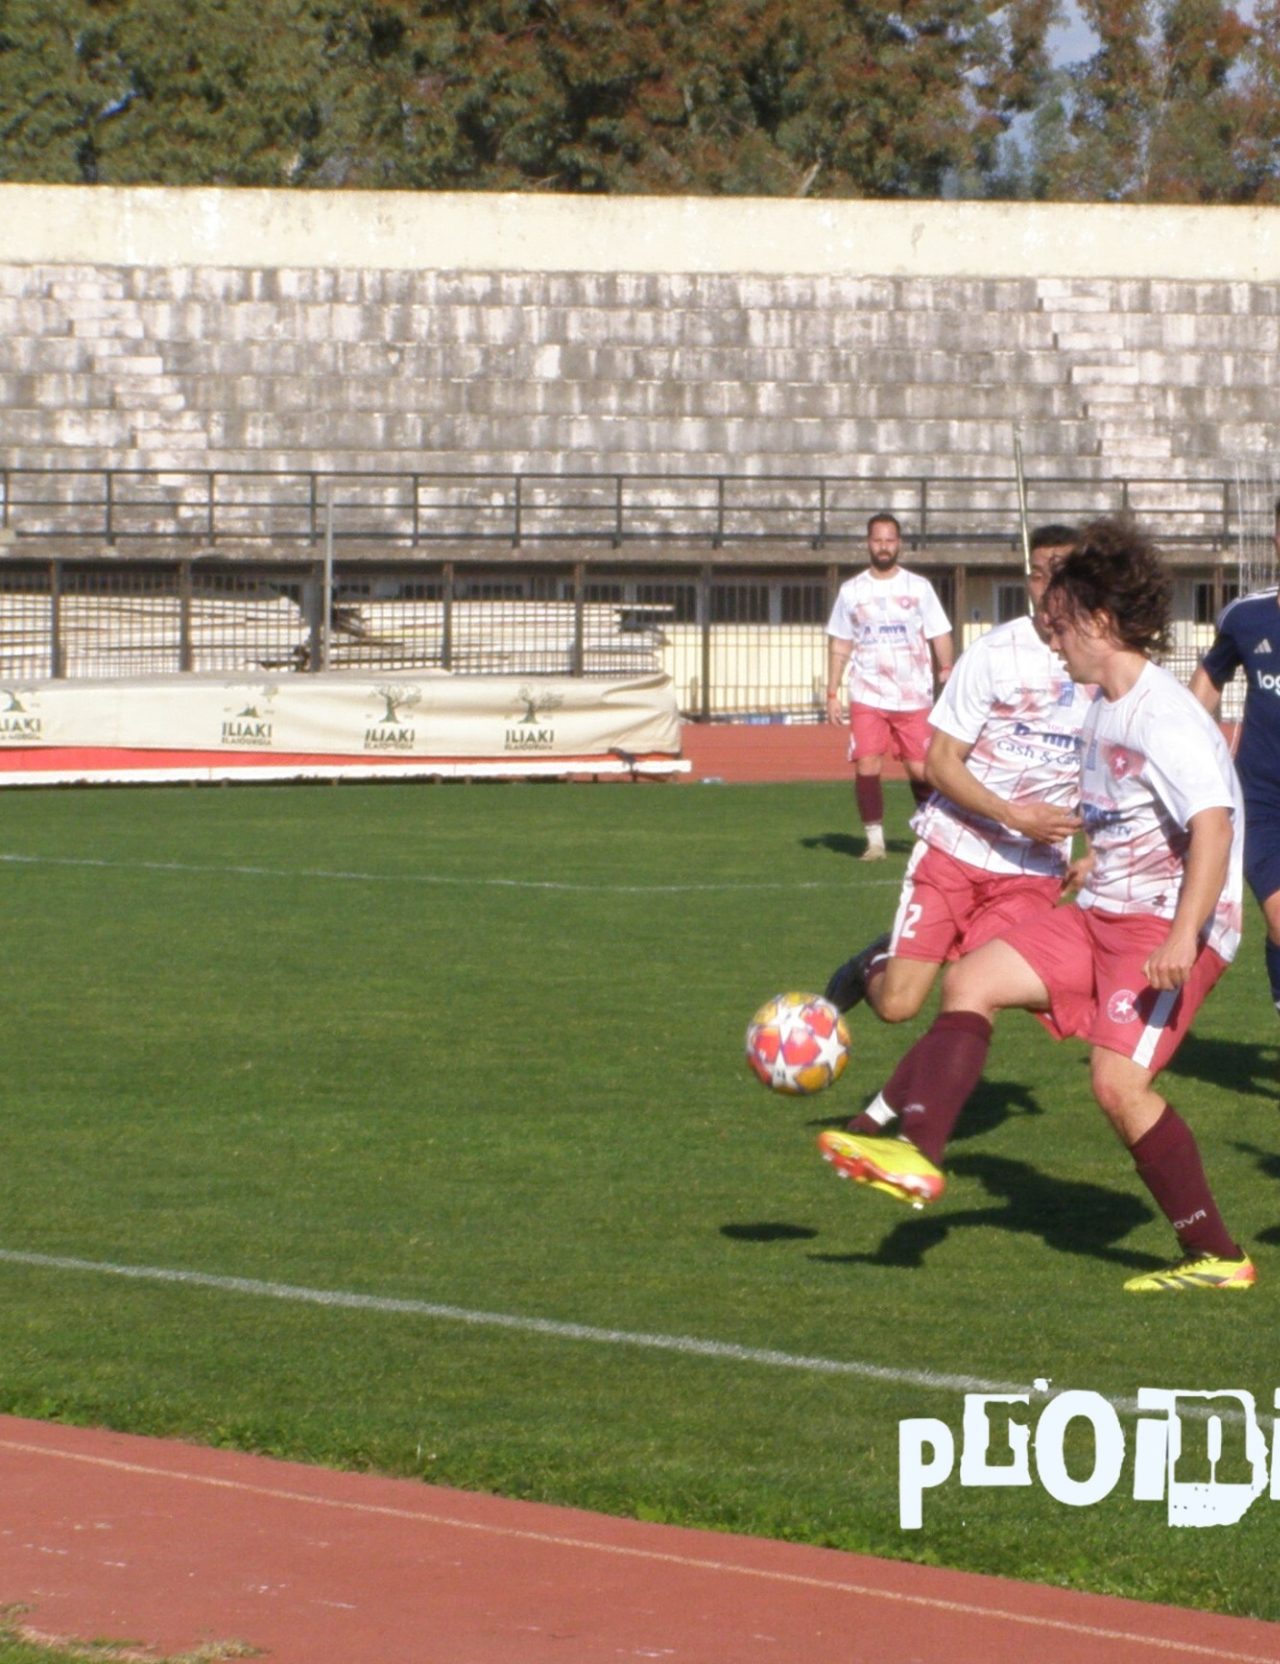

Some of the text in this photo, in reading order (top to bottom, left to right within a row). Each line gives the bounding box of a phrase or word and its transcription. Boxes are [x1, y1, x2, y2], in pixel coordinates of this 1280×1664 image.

[0, 718, 41, 733] IAKI
[222, 722, 272, 737] ILIAKI
[365, 729, 415, 742] ILIAKI
[506, 729, 555, 743] ILIAKI
[997, 740, 1034, 758] cash
[901, 903, 923, 939] 2
